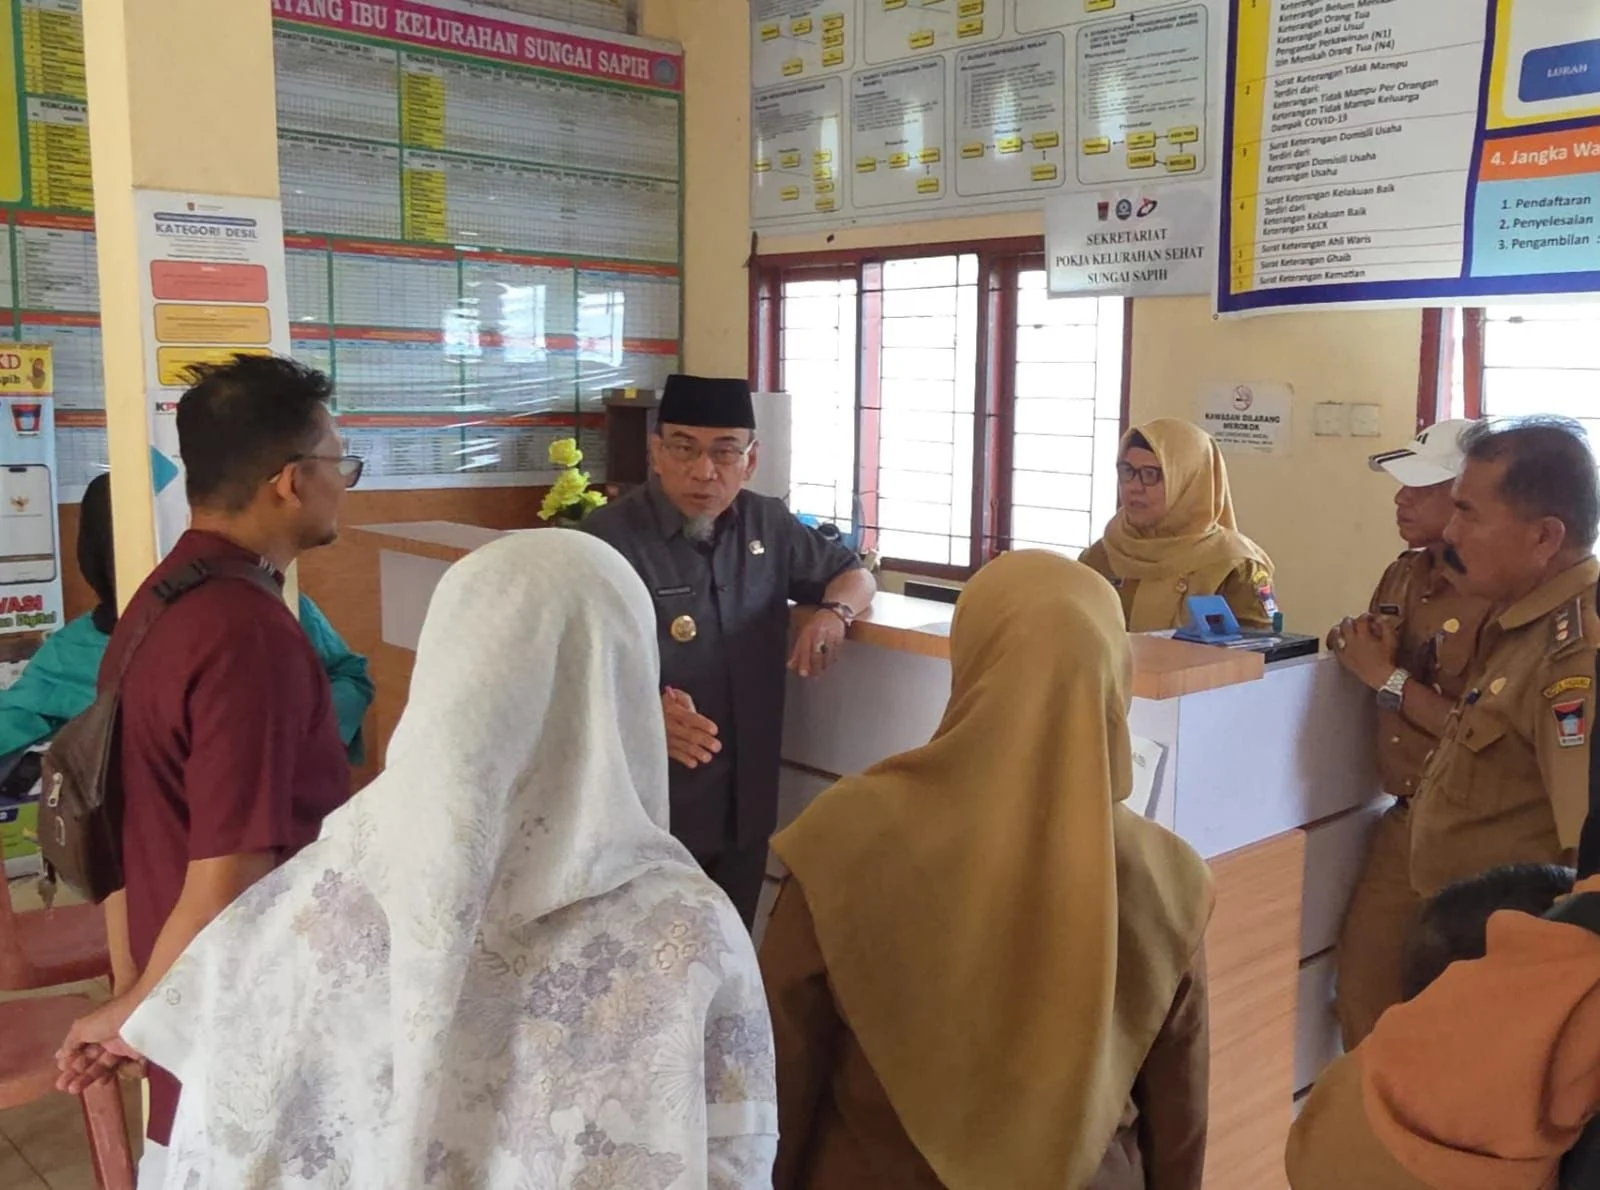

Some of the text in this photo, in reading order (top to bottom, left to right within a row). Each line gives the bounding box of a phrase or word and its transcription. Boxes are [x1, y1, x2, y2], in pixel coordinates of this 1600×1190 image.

[1278, 11, 1370, 33] Keterangan Orang Tua
[351, 1, 388, 29] IBU
[395, 9, 518, 56] KELURAHAN
[524, 36, 593, 70] SUNGAI
[598, 51, 650, 79] SAPIH
[1276, 22, 1365, 44] Keterangan Asal Usul
[1275, 41, 1317, 56] Pengantar
[1318, 33, 1370, 48] Perkawinan
[1328, 45, 1353, 57] Orang
[1356, 43, 1372, 52] Tua
[1274, 60, 1408, 87] Surat Keterangan Tidak Mampu
[1547, 63, 1588, 78] LURAH
[1273, 79, 1439, 109] Keterangan Tidak Mampu Per Orangan
[1272, 93, 1419, 121] Keterangan Tidak Mampu Keluarga
[1269, 123, 1402, 151] Surat Keterangan Domisili Usaha
[1267, 151, 1376, 173] Keterangan Domisili Usaha
[1490, 141, 1600, 166] 4. Jangka Wa
[1266, 168, 1338, 184] Keterangan Usaha
[1264, 184, 1395, 206] Surat Keterangan Kelakuan Baik
[1501, 194, 1591, 210] 1. Pendaftaran
[1263, 207, 1367, 225] Keterangan Kelakuan Baik
[1499, 214, 1593, 231] 2. Penyelesaian
[156, 222, 257, 238] KATEGORI DESIL
[1086, 228, 1168, 246] SEKRETARIAT
[1262, 221, 1328, 236] Keterangan SKCK
[1261, 234, 1372, 253] Surat Keterangan Ahli Waris
[1497, 239, 1508, 250] 3.
[1511, 233, 1590, 251] Pengambilan
[1056, 246, 1205, 267] POKJA KELURAHAN SEHAT
[1260, 252, 1352, 269] Surat Keterangan Ghaib
[1087, 268, 1168, 284] SUNGAI SAPIH
[1259, 269, 1366, 285] Surat Keterangan Kematian
[1205, 412, 1280, 424] KAWASAN DILARANG
[1223, 422, 1260, 431] MEROKOK
